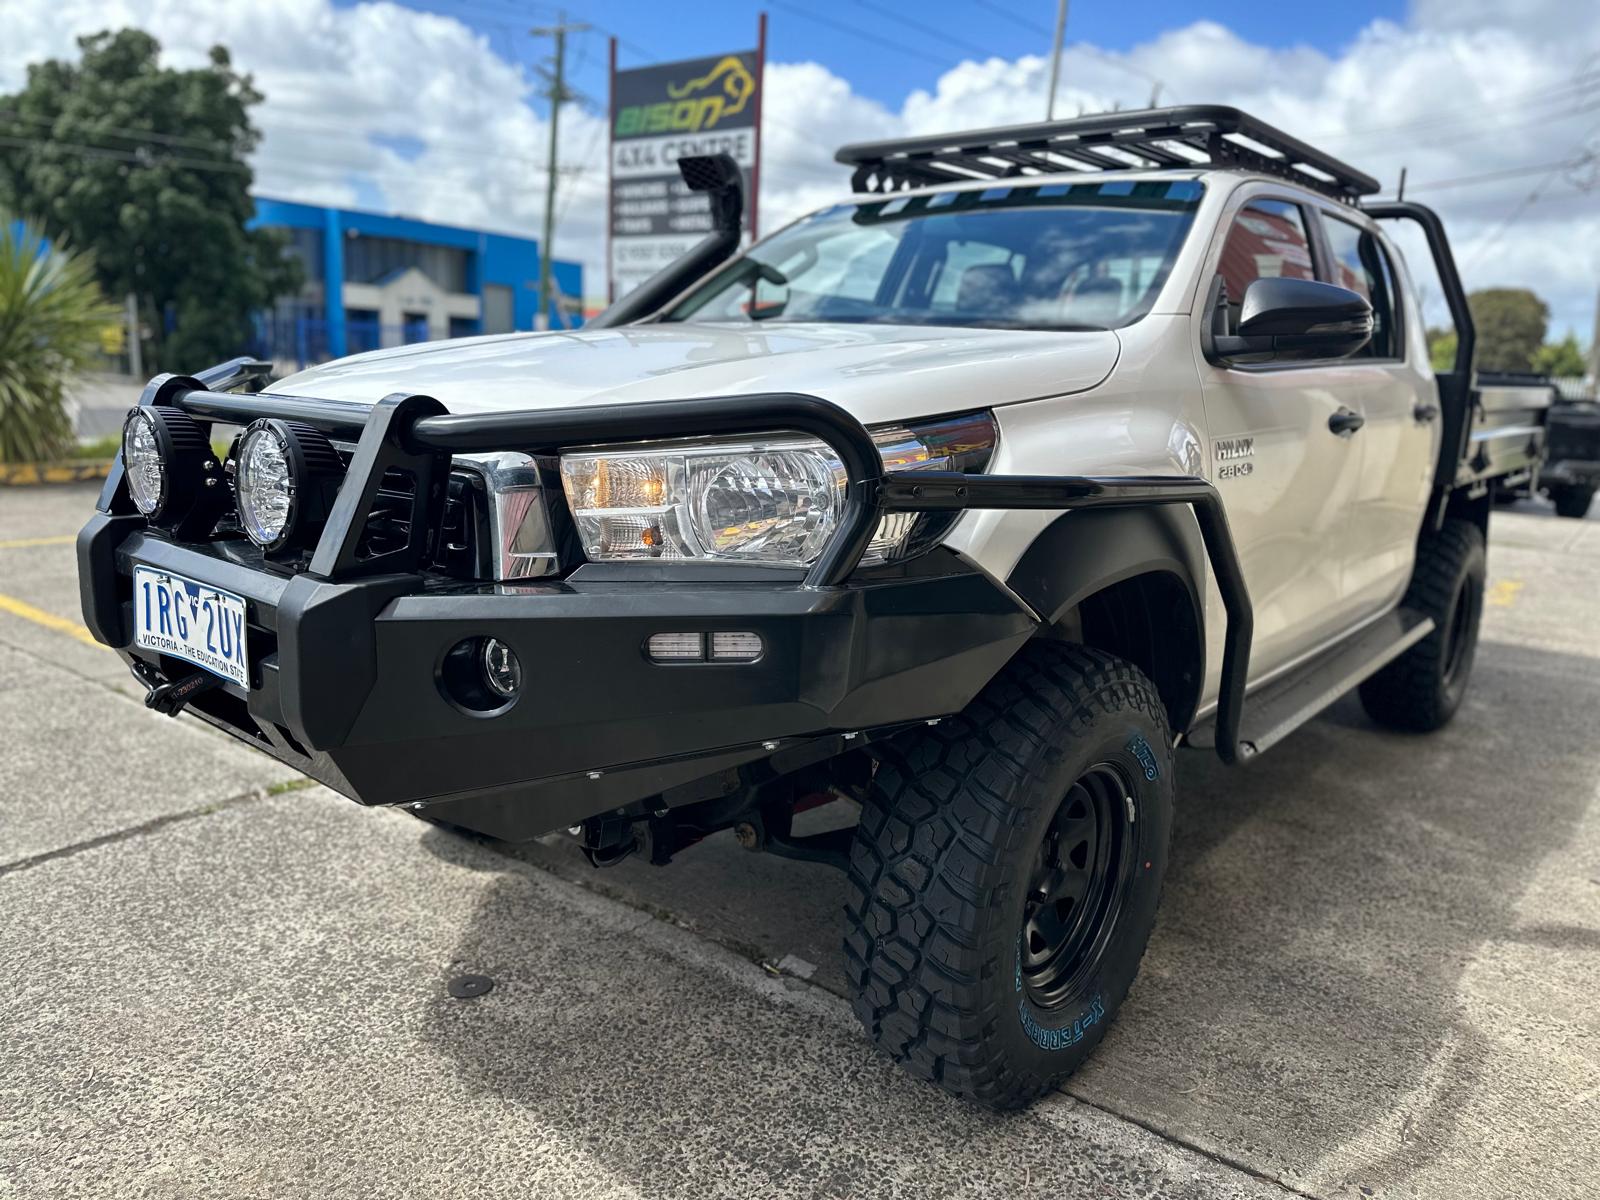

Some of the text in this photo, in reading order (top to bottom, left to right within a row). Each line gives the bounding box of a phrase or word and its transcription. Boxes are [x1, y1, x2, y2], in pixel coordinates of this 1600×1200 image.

[615, 96, 725, 136] BISON
[660, 134, 747, 167] CENTRE
[188, 595, 199, 607] VIC
[143, 582, 246, 669] 1RG 2UX
[142, 634, 179, 651] VICTORIA
[183, 644, 197, 658] THE
[196, 649, 229, 673] EDUCATION
[229, 664, 244, 683] STATE
